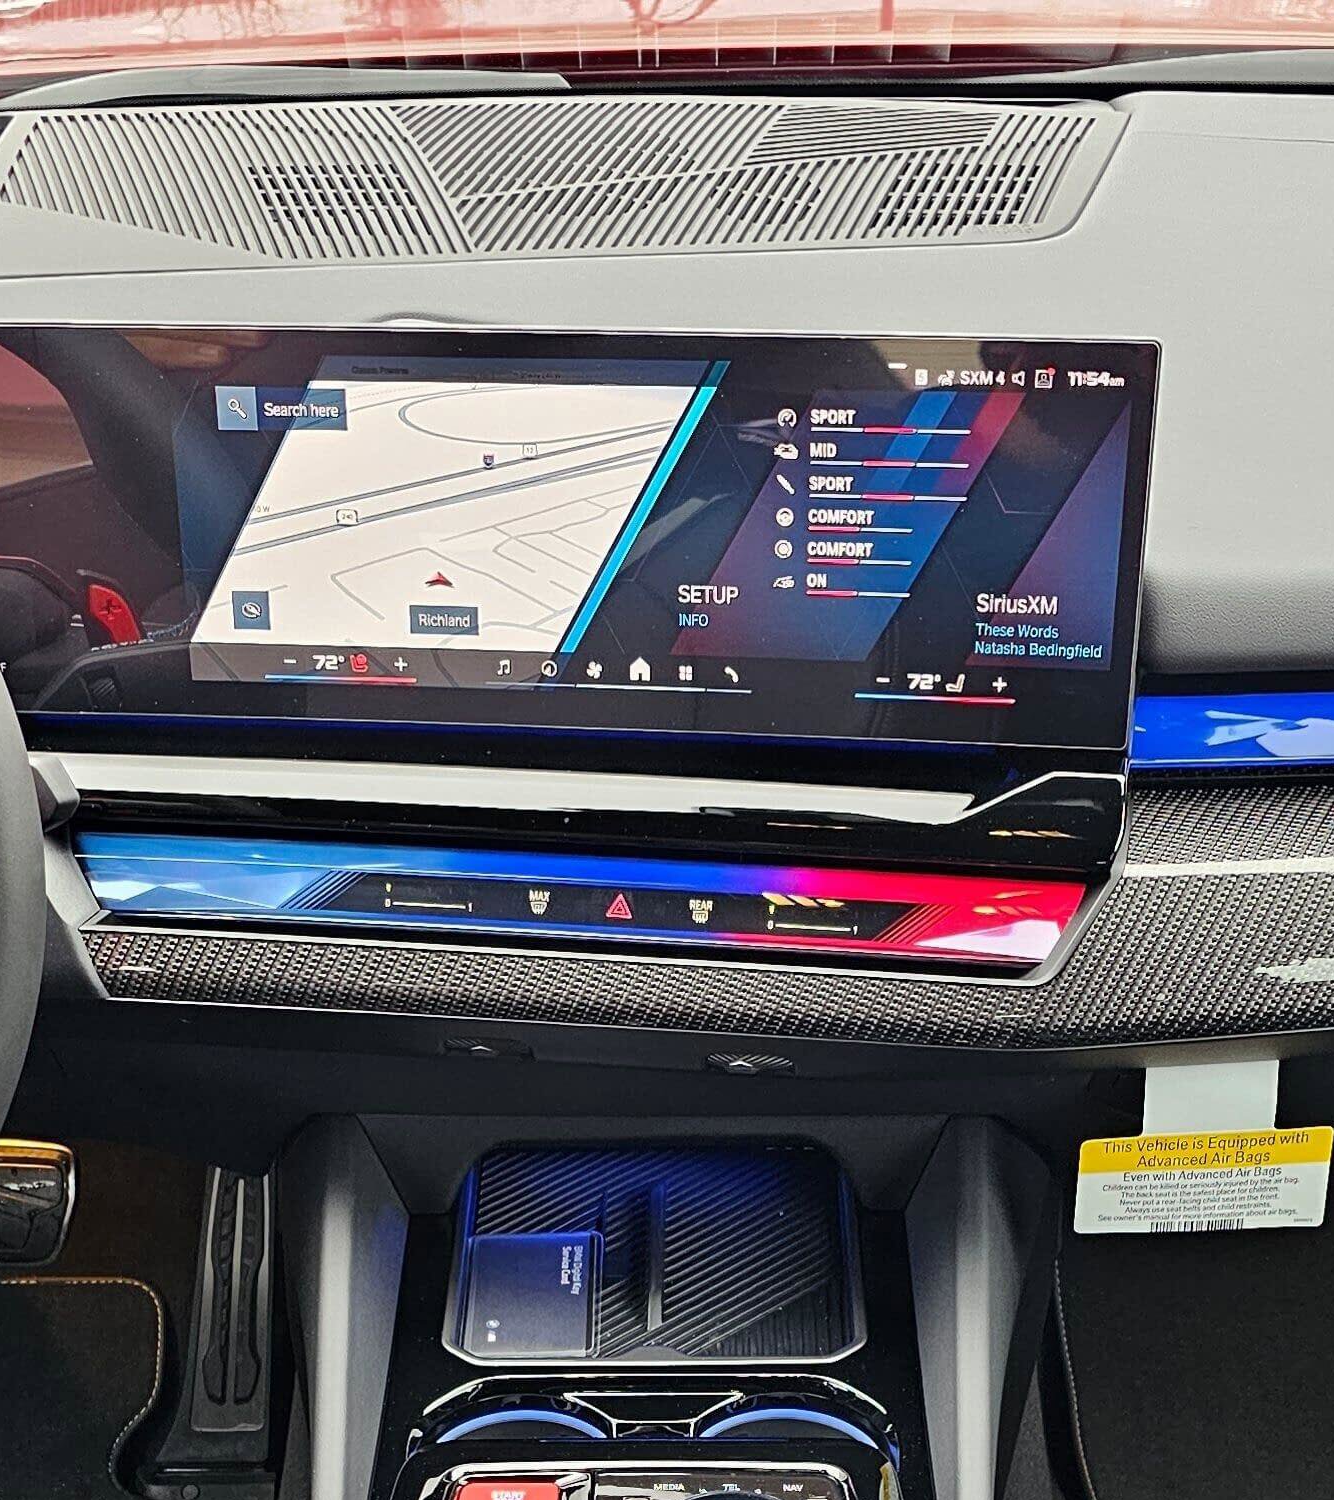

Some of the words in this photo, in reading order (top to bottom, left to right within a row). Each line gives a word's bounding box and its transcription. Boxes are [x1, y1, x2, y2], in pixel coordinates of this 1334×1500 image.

[959, 370, 993, 386] SXM
[995, 370, 1006, 386] 4
[263, 402, 307, 417] Search
[310, 403, 339, 417] here
[810, 409, 856, 424] SPORT
[809, 442, 837, 458] MID
[808, 475, 854, 491] SPORT
[807, 508, 875, 525] COMFORT
[806, 541, 874, 557] COMFORT
[806, 573, 827, 588] ON
[677, 584, 739, 605] SETUP
[975, 593, 1058, 615] SiriusXM
[419, 613, 471, 627] Richland
[678, 613, 709, 627] INFO
[975, 622, 1015, 637] These
[1018, 624, 1059, 639] Words
[974, 641, 1025, 656] Natasha
[1029, 643, 1103, 660] Bedingfield
[312, 654, 345, 670] 72°
[907, 673, 941, 690] 72°
[528, 889, 551, 902] MAX
[689, 899, 713, 912] REAR
[1103, 1141, 1132, 1154] This
[1136, 1138, 1189, 1152] Vehicle
[1192, 1137, 1204, 1150] is
[1208, 1134, 1276, 1151] Equipped
[1280, 1131, 1309, 1145] with
[1136, 1153, 1208, 1168] Advanced
[1211, 1152, 1232, 1165] Air
[1235, 1150, 1271, 1165] Bags
[1123, 1171, 1150, 1182] Even
[1153, 1170, 1176, 1181] with
[1178, 1169, 1233, 1181] Advanced
[1235, 1168, 1252, 1178] Air
[1254, 1166, 1282, 1178] Bags
[1102, 1184, 1133, 1192] Children
[1260, 1177, 1272, 1185] the
[1216, 1188, 1235, 1196] place
[1202, 1196, 1221, 1204] child
[1125, 1206, 1151, 1214] Always
[1171, 1212, 1182, 1220] for
[1203, 1210, 1244, 1218] information
[1245, 1208, 1266, 1216] about
[653, 1483, 685, 1491] MEDIA
[722, 1483, 740, 1491] TEL
[782, 1484, 803, 1492] NAV
